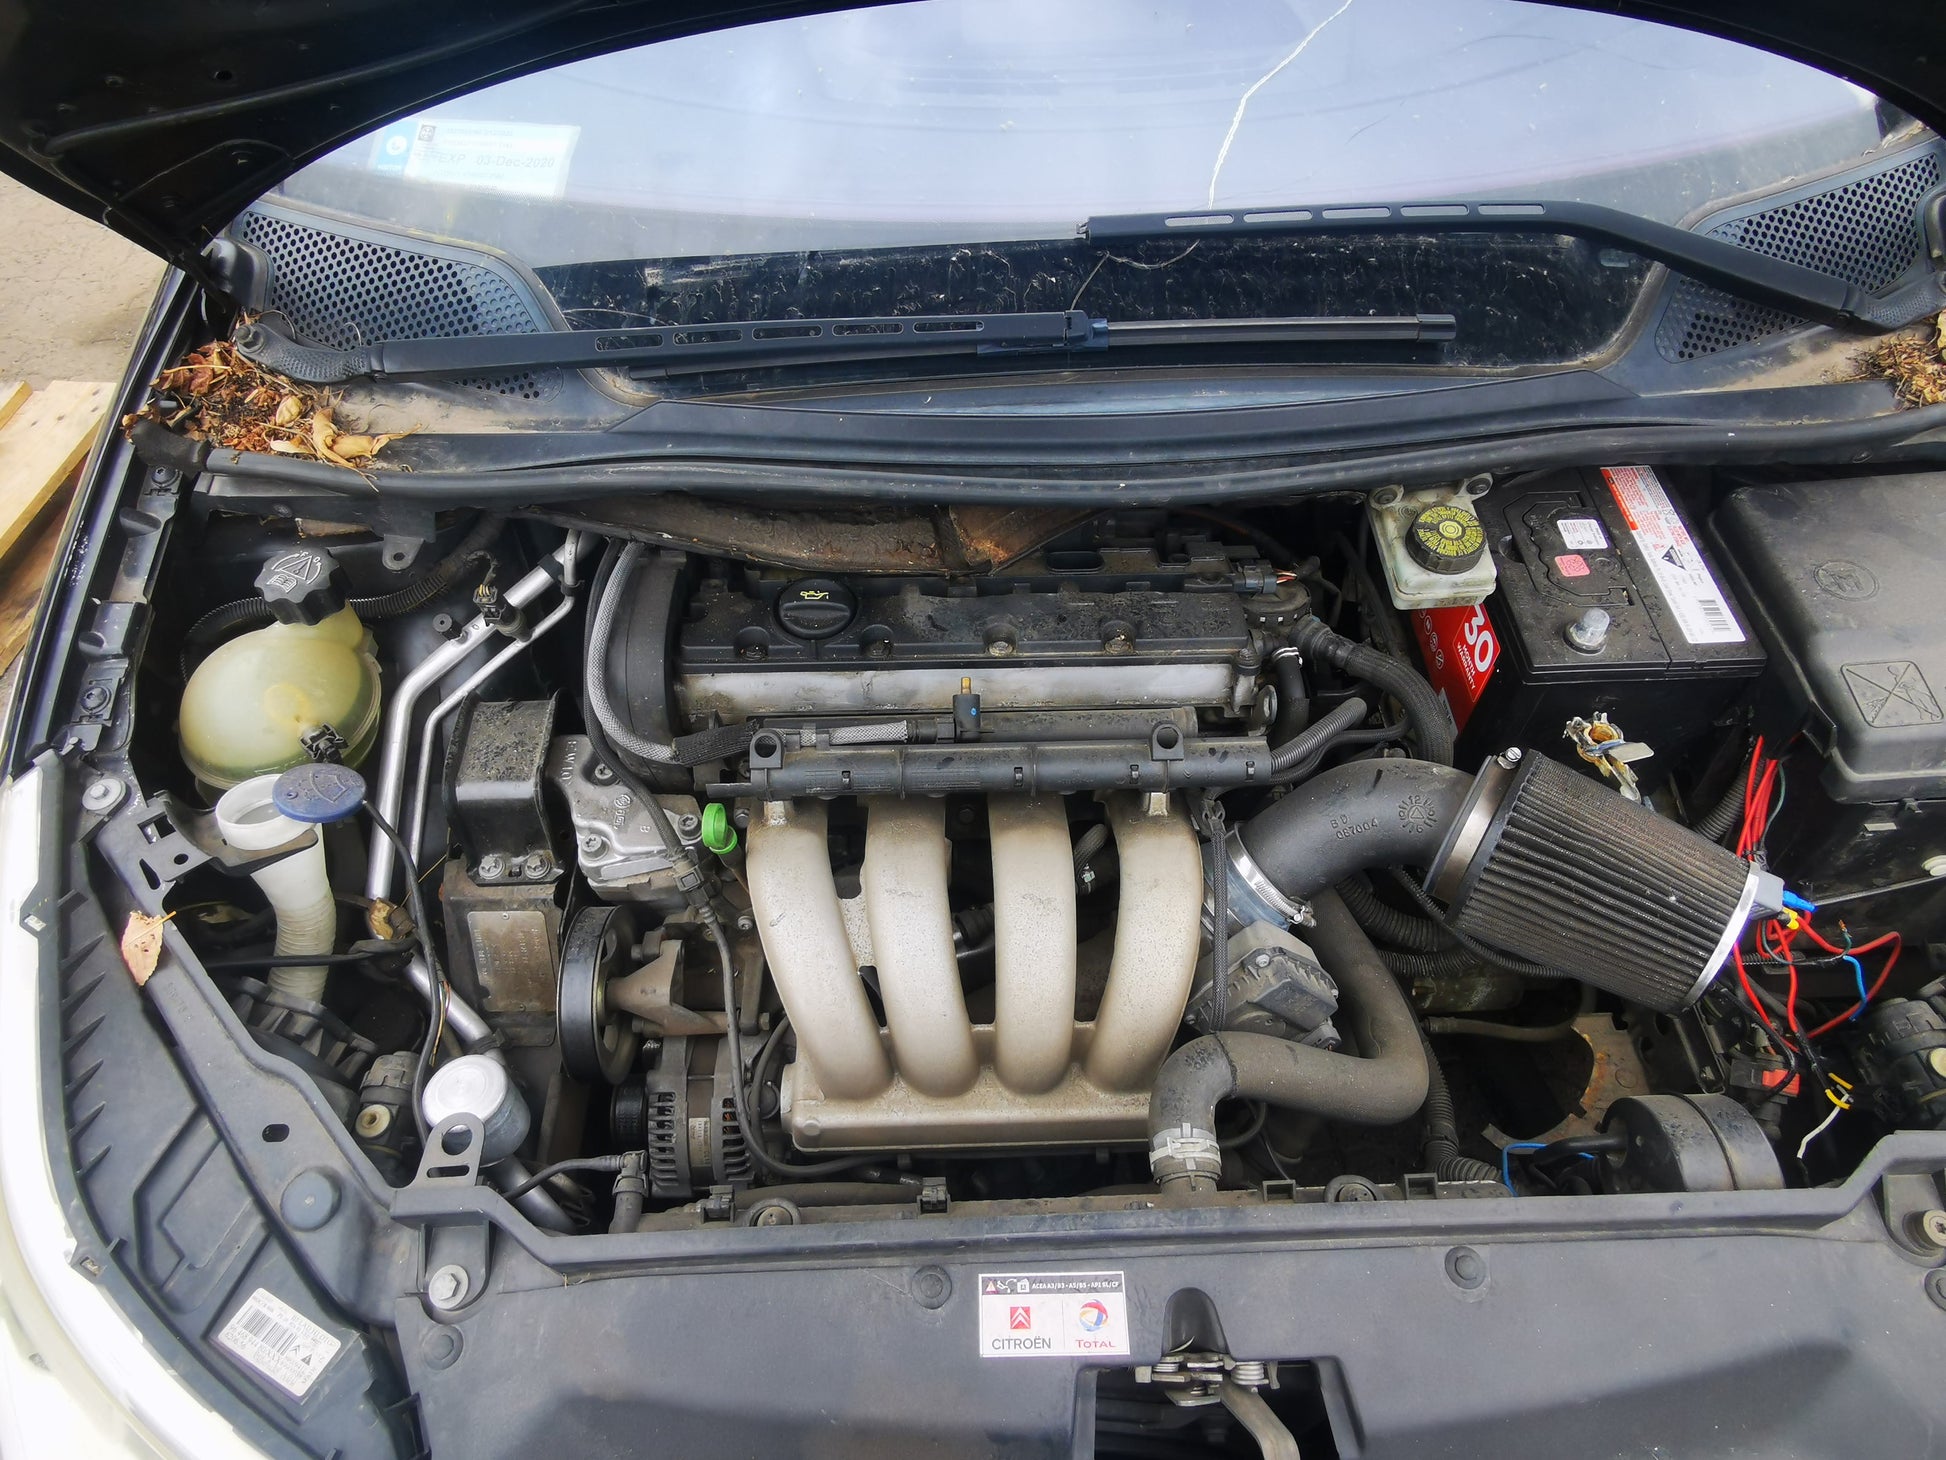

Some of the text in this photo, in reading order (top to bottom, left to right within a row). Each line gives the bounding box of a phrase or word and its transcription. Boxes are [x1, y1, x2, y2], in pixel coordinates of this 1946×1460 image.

[439, 153, 467, 165] EXP
[1464, 603, 1494, 672] 30
[1457, 641, 1476, 690] WARRANTY
[1462, 644, 1476, 677] MONTH
[991, 1335, 1116, 1350] CITROËN TOTAL
